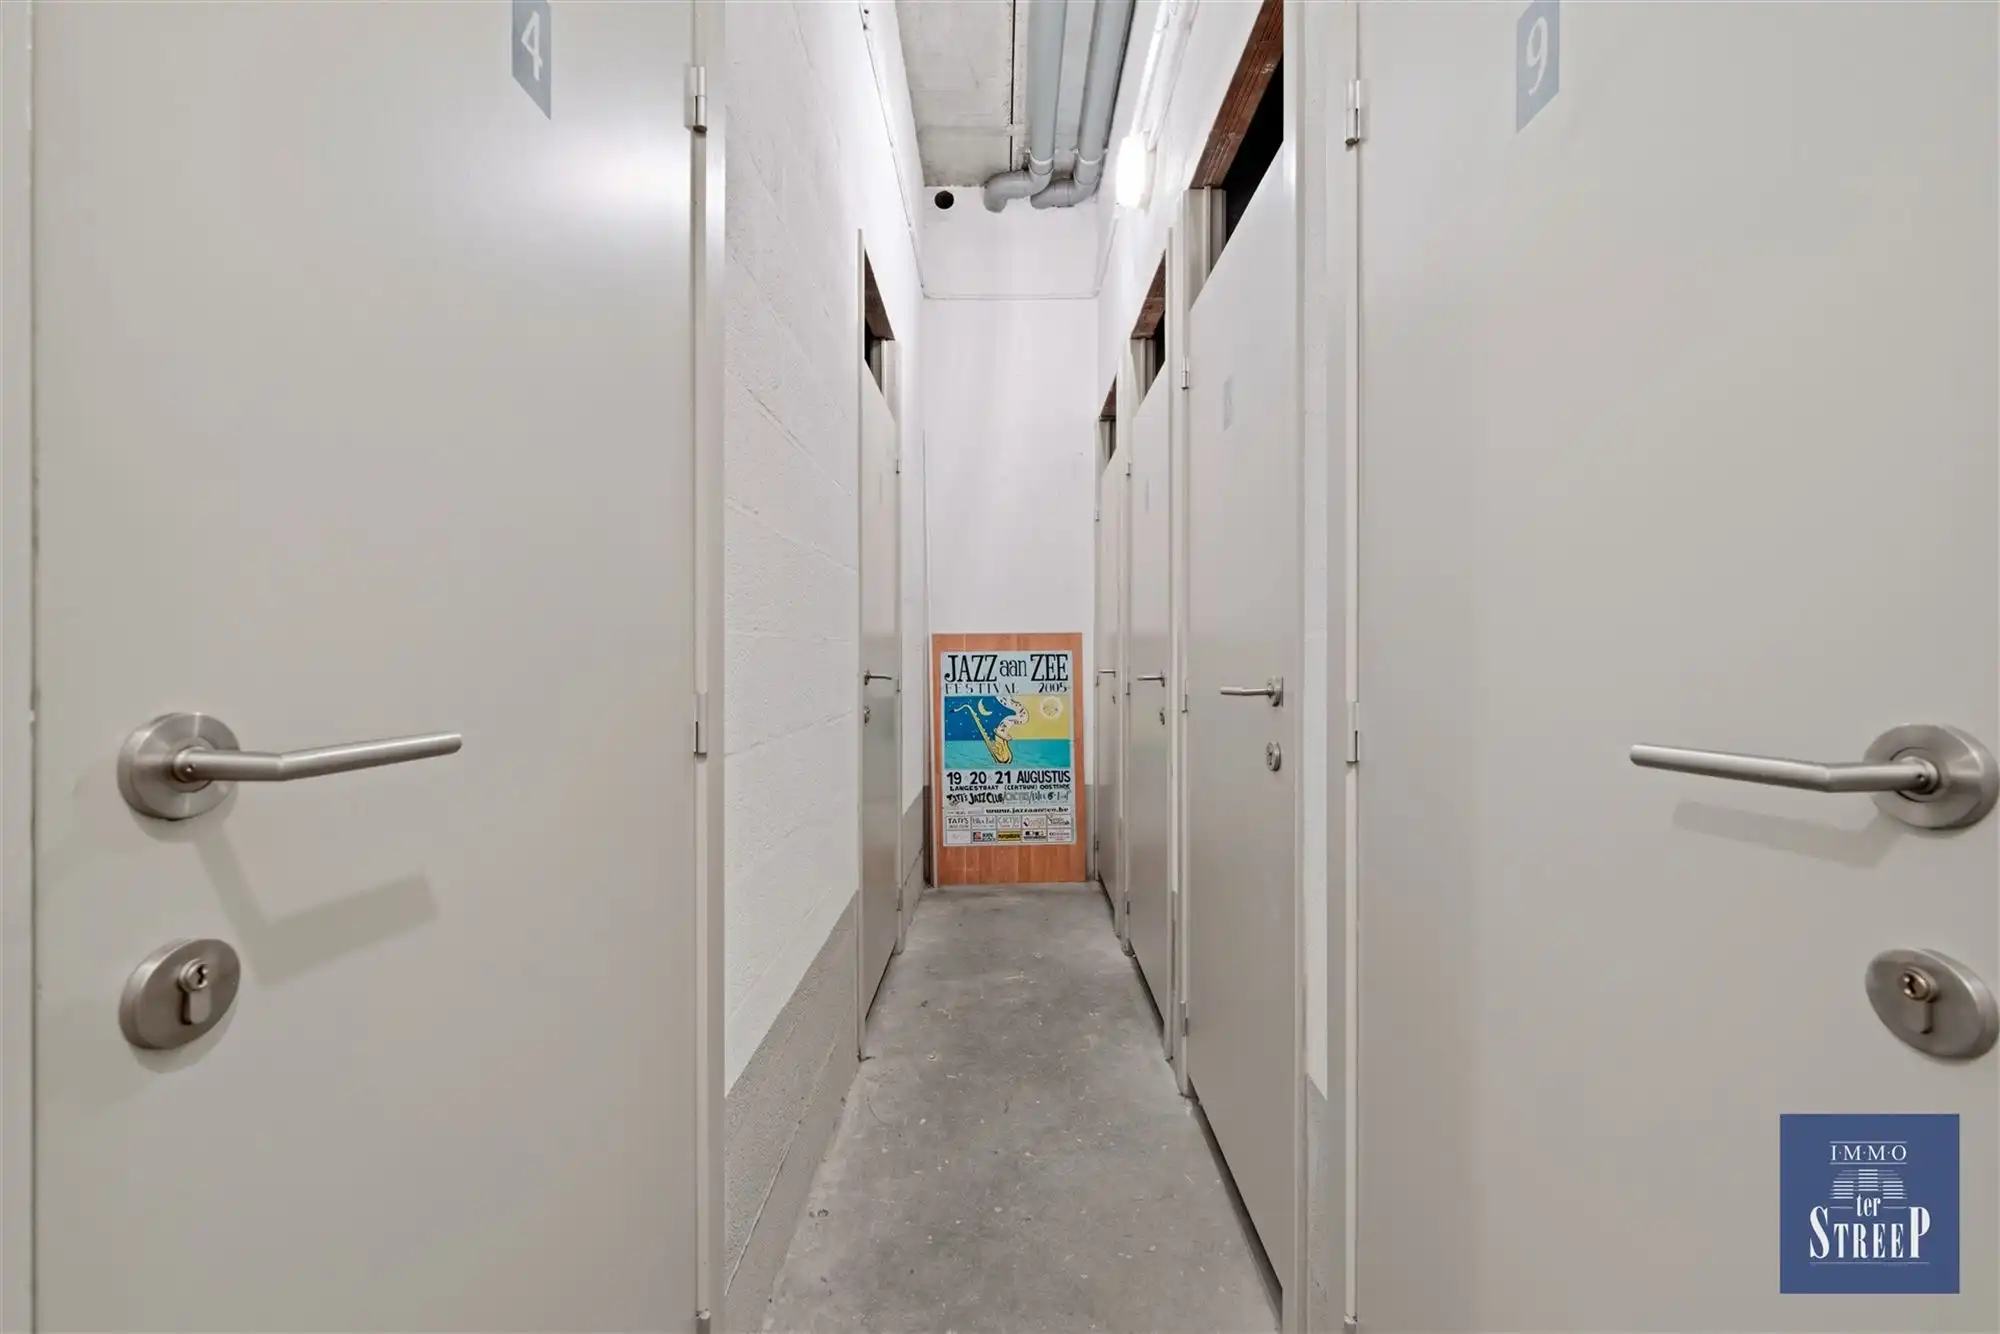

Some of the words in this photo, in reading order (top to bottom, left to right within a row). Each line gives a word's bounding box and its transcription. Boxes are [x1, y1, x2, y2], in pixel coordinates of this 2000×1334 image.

[520, 11, 543, 81] 4
[1526, 16, 1548, 96] 9
[944, 654, 998, 682] JAZZ
[999, 659, 1027, 677] aan
[1030, 654, 1069, 682] ZEE
[945, 682, 1019, 694] FESTIVAL
[1038, 682, 1068, 693] 2005
[946, 771, 962, 785] 19
[969, 771, 987, 785] 20
[995, 770, 1011, 784] 21
[1016, 770, 1071, 784] AUGUSTUS
